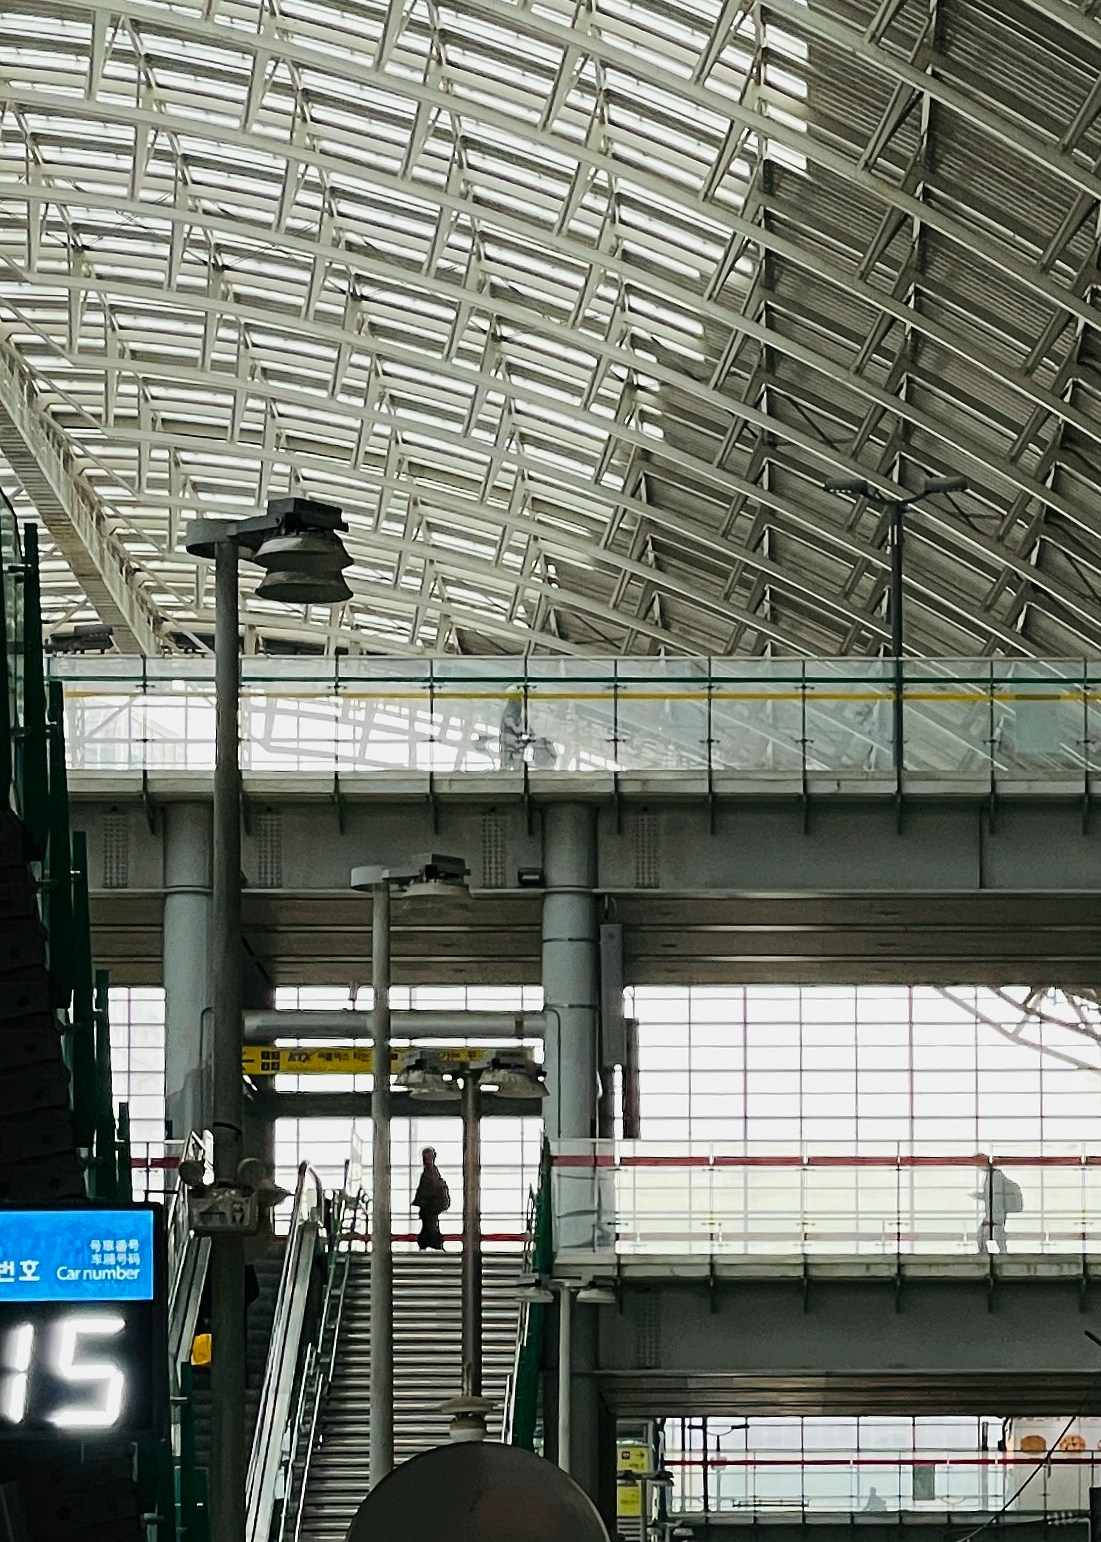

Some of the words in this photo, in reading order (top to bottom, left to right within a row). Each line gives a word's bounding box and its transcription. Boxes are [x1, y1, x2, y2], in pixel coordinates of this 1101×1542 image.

[56, 1266, 80, 1281] Car
[83, 1265, 140, 1280] number
[8, 1317, 126, 1427] 15
